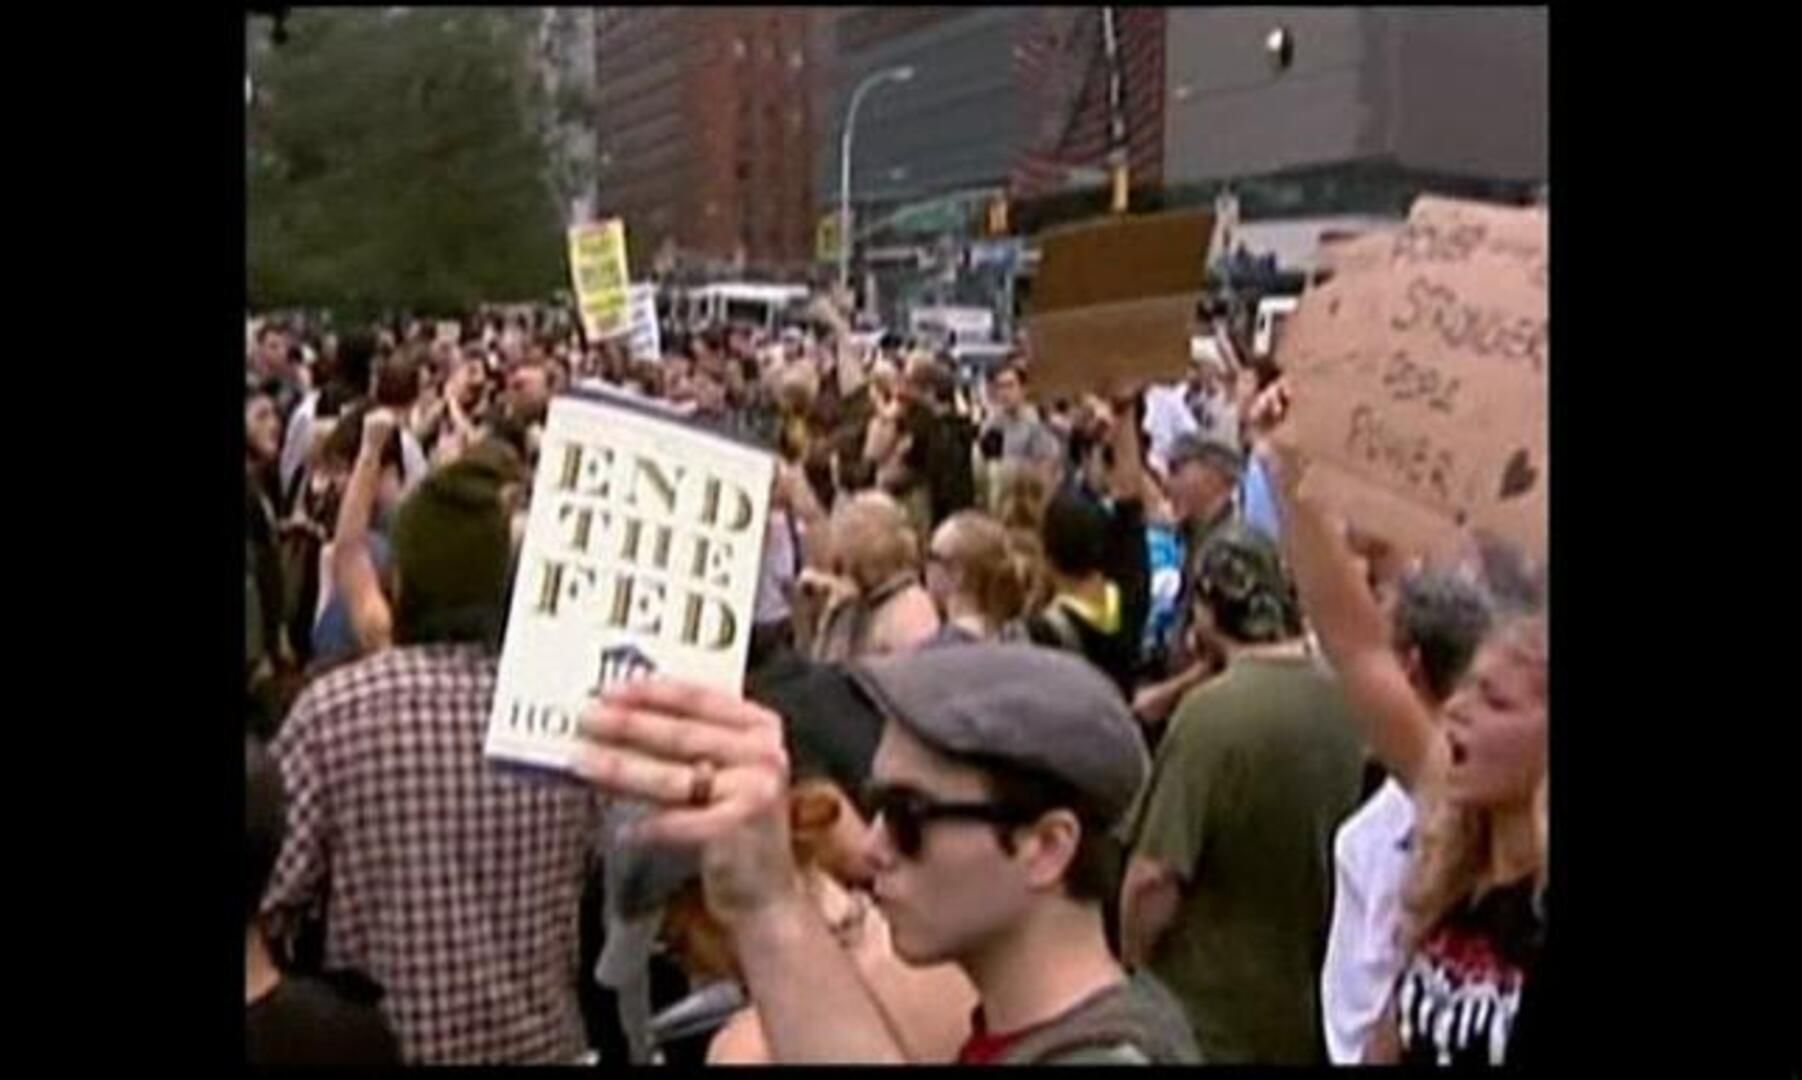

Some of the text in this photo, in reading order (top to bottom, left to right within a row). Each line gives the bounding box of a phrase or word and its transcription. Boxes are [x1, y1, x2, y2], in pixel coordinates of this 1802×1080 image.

[559, 442, 754, 533] END
[559, 503, 735, 586] THE
[537, 559, 738, 651] FED
